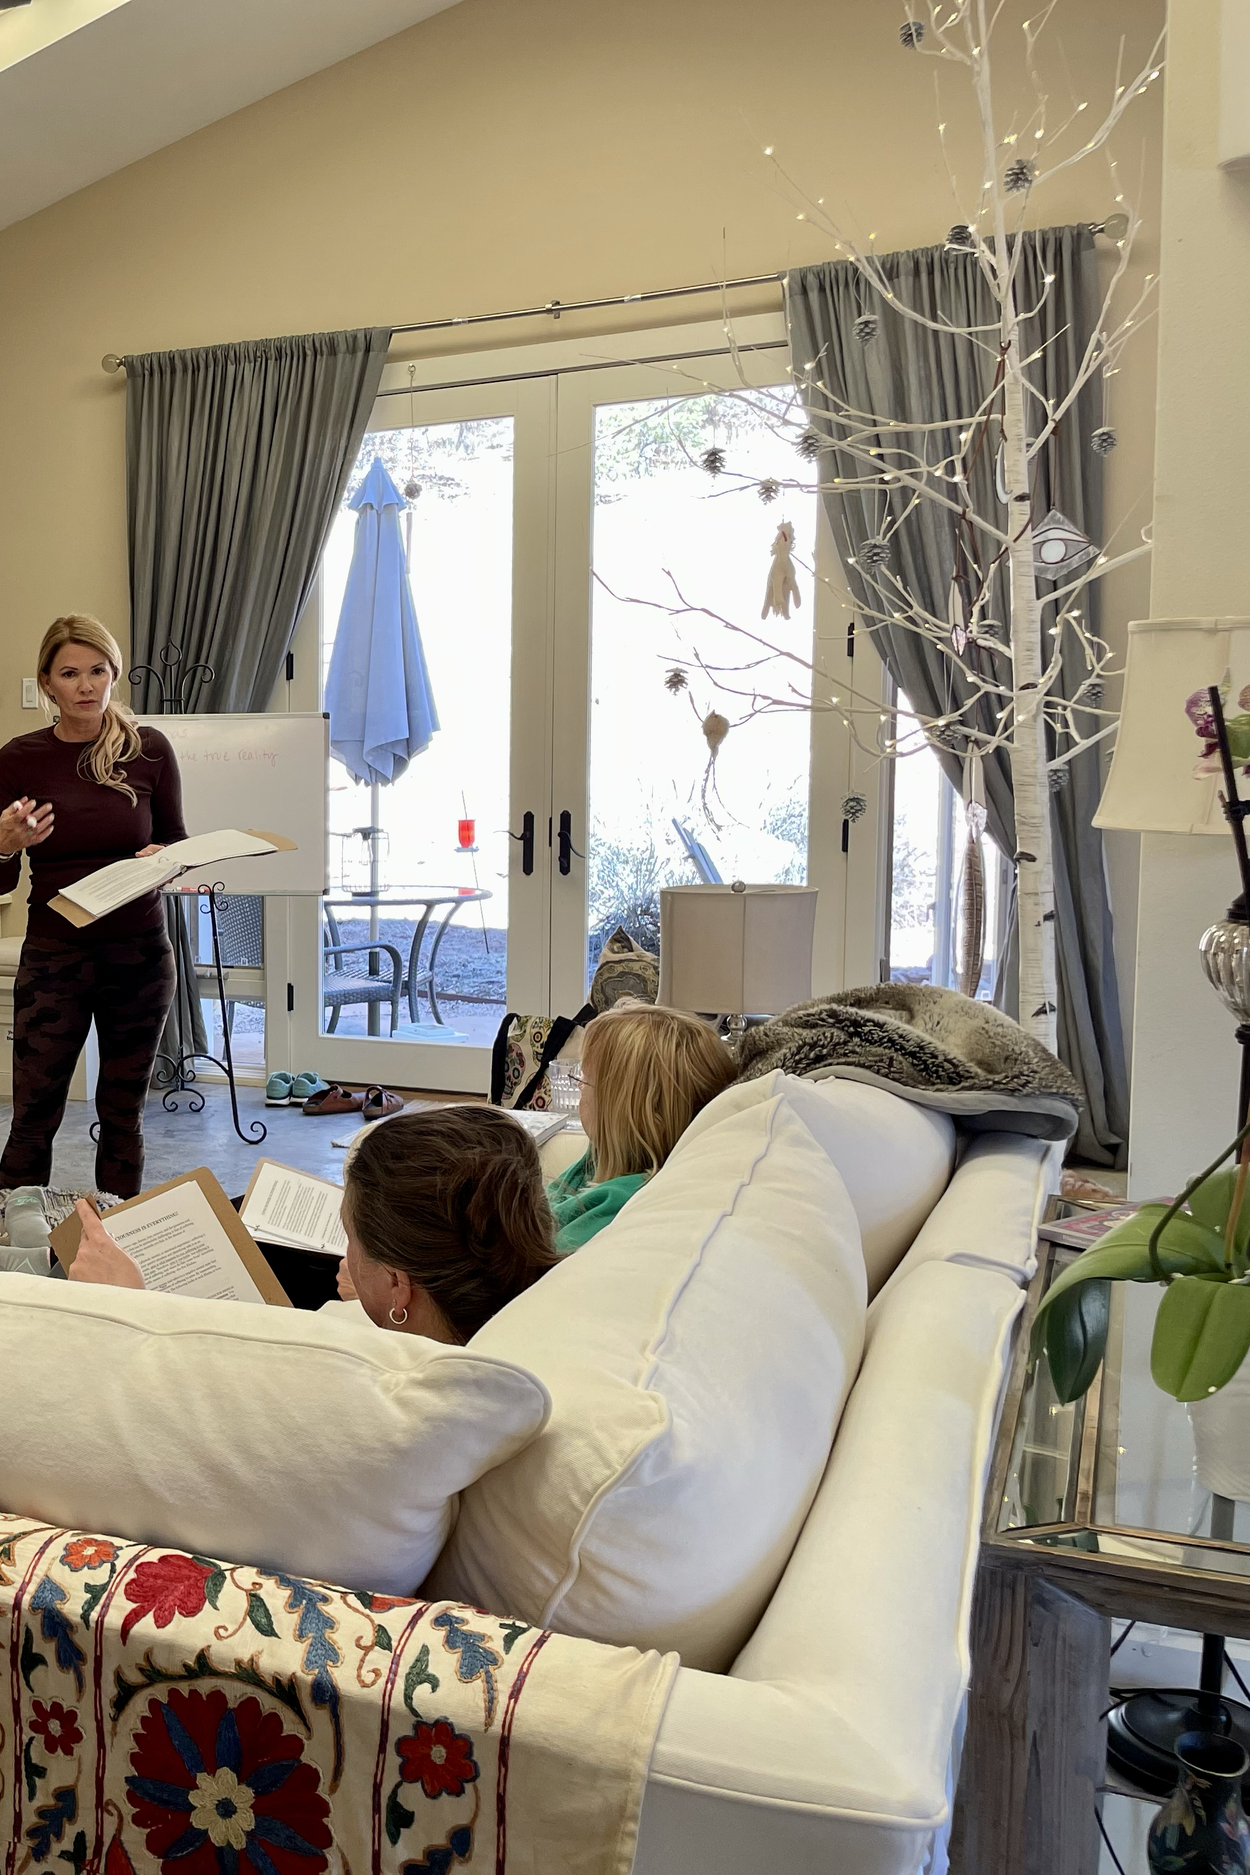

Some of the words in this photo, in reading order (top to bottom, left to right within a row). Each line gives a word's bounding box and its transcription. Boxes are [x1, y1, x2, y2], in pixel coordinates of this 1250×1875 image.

[180, 750, 199, 762] the
[203, 751, 230, 762] true
[238, 750, 279, 768] reality
